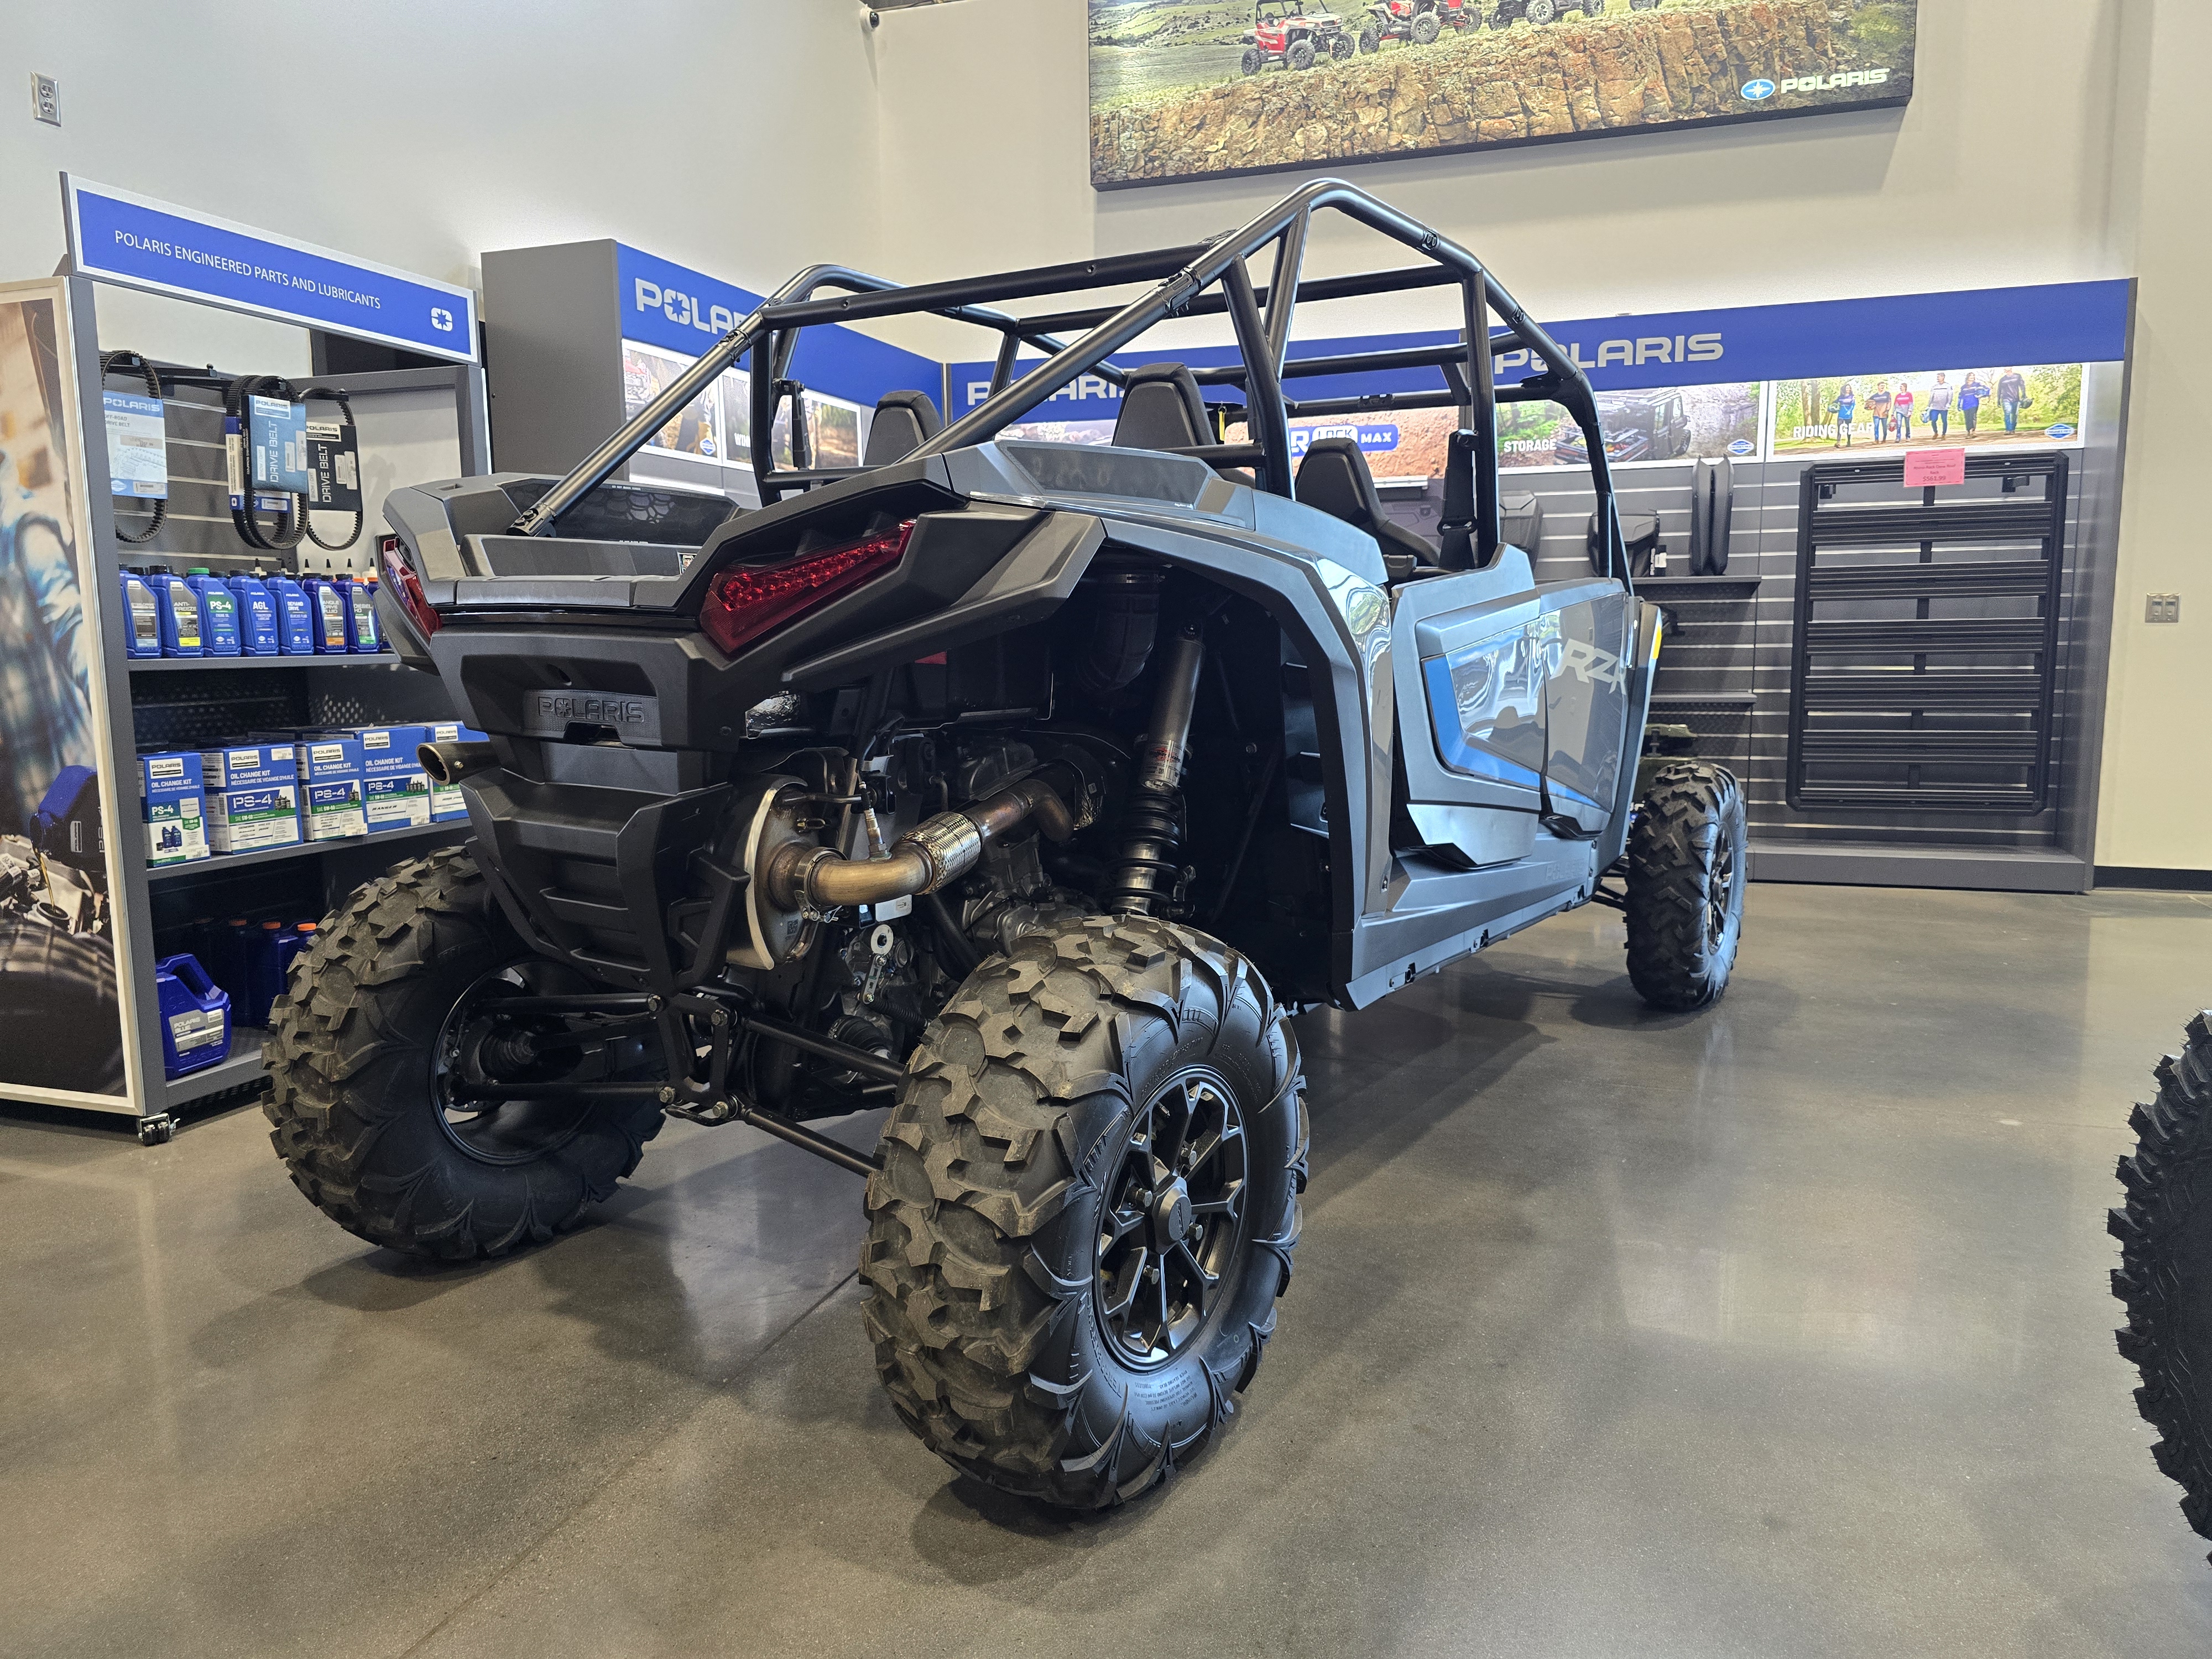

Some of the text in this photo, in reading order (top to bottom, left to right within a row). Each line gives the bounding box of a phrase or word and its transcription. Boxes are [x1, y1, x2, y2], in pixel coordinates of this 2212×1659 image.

[1781, 68, 1890, 94] POLARIS
[115, 231, 380, 309] POLARIS ENGINEERED PARTS AND LUBRICANTS
[635, 278, 747, 335] POLA
[967, 375, 1125, 405] PARI
[103, 397, 160, 412] POLARIS
[256, 400, 289, 409] POLARIS
[1793, 422, 1875, 439] RIDING GEAR
[1360, 432, 1392, 444] MAX
[268, 420, 279, 483] DRIVE BELT
[1504, 439, 1557, 453] STORAGE
[317, 443, 332, 503] DRIVE BELT
[210, 601, 231, 610] PS-4
[253, 602, 269, 610] AGL
[538, 697, 645, 723] POLARIS
[315, 787, 346, 799] PS-4
[368, 781, 394, 791] PS-4
[233, 794, 272, 808] PS-4
[152, 805, 174, 815] PS-4
